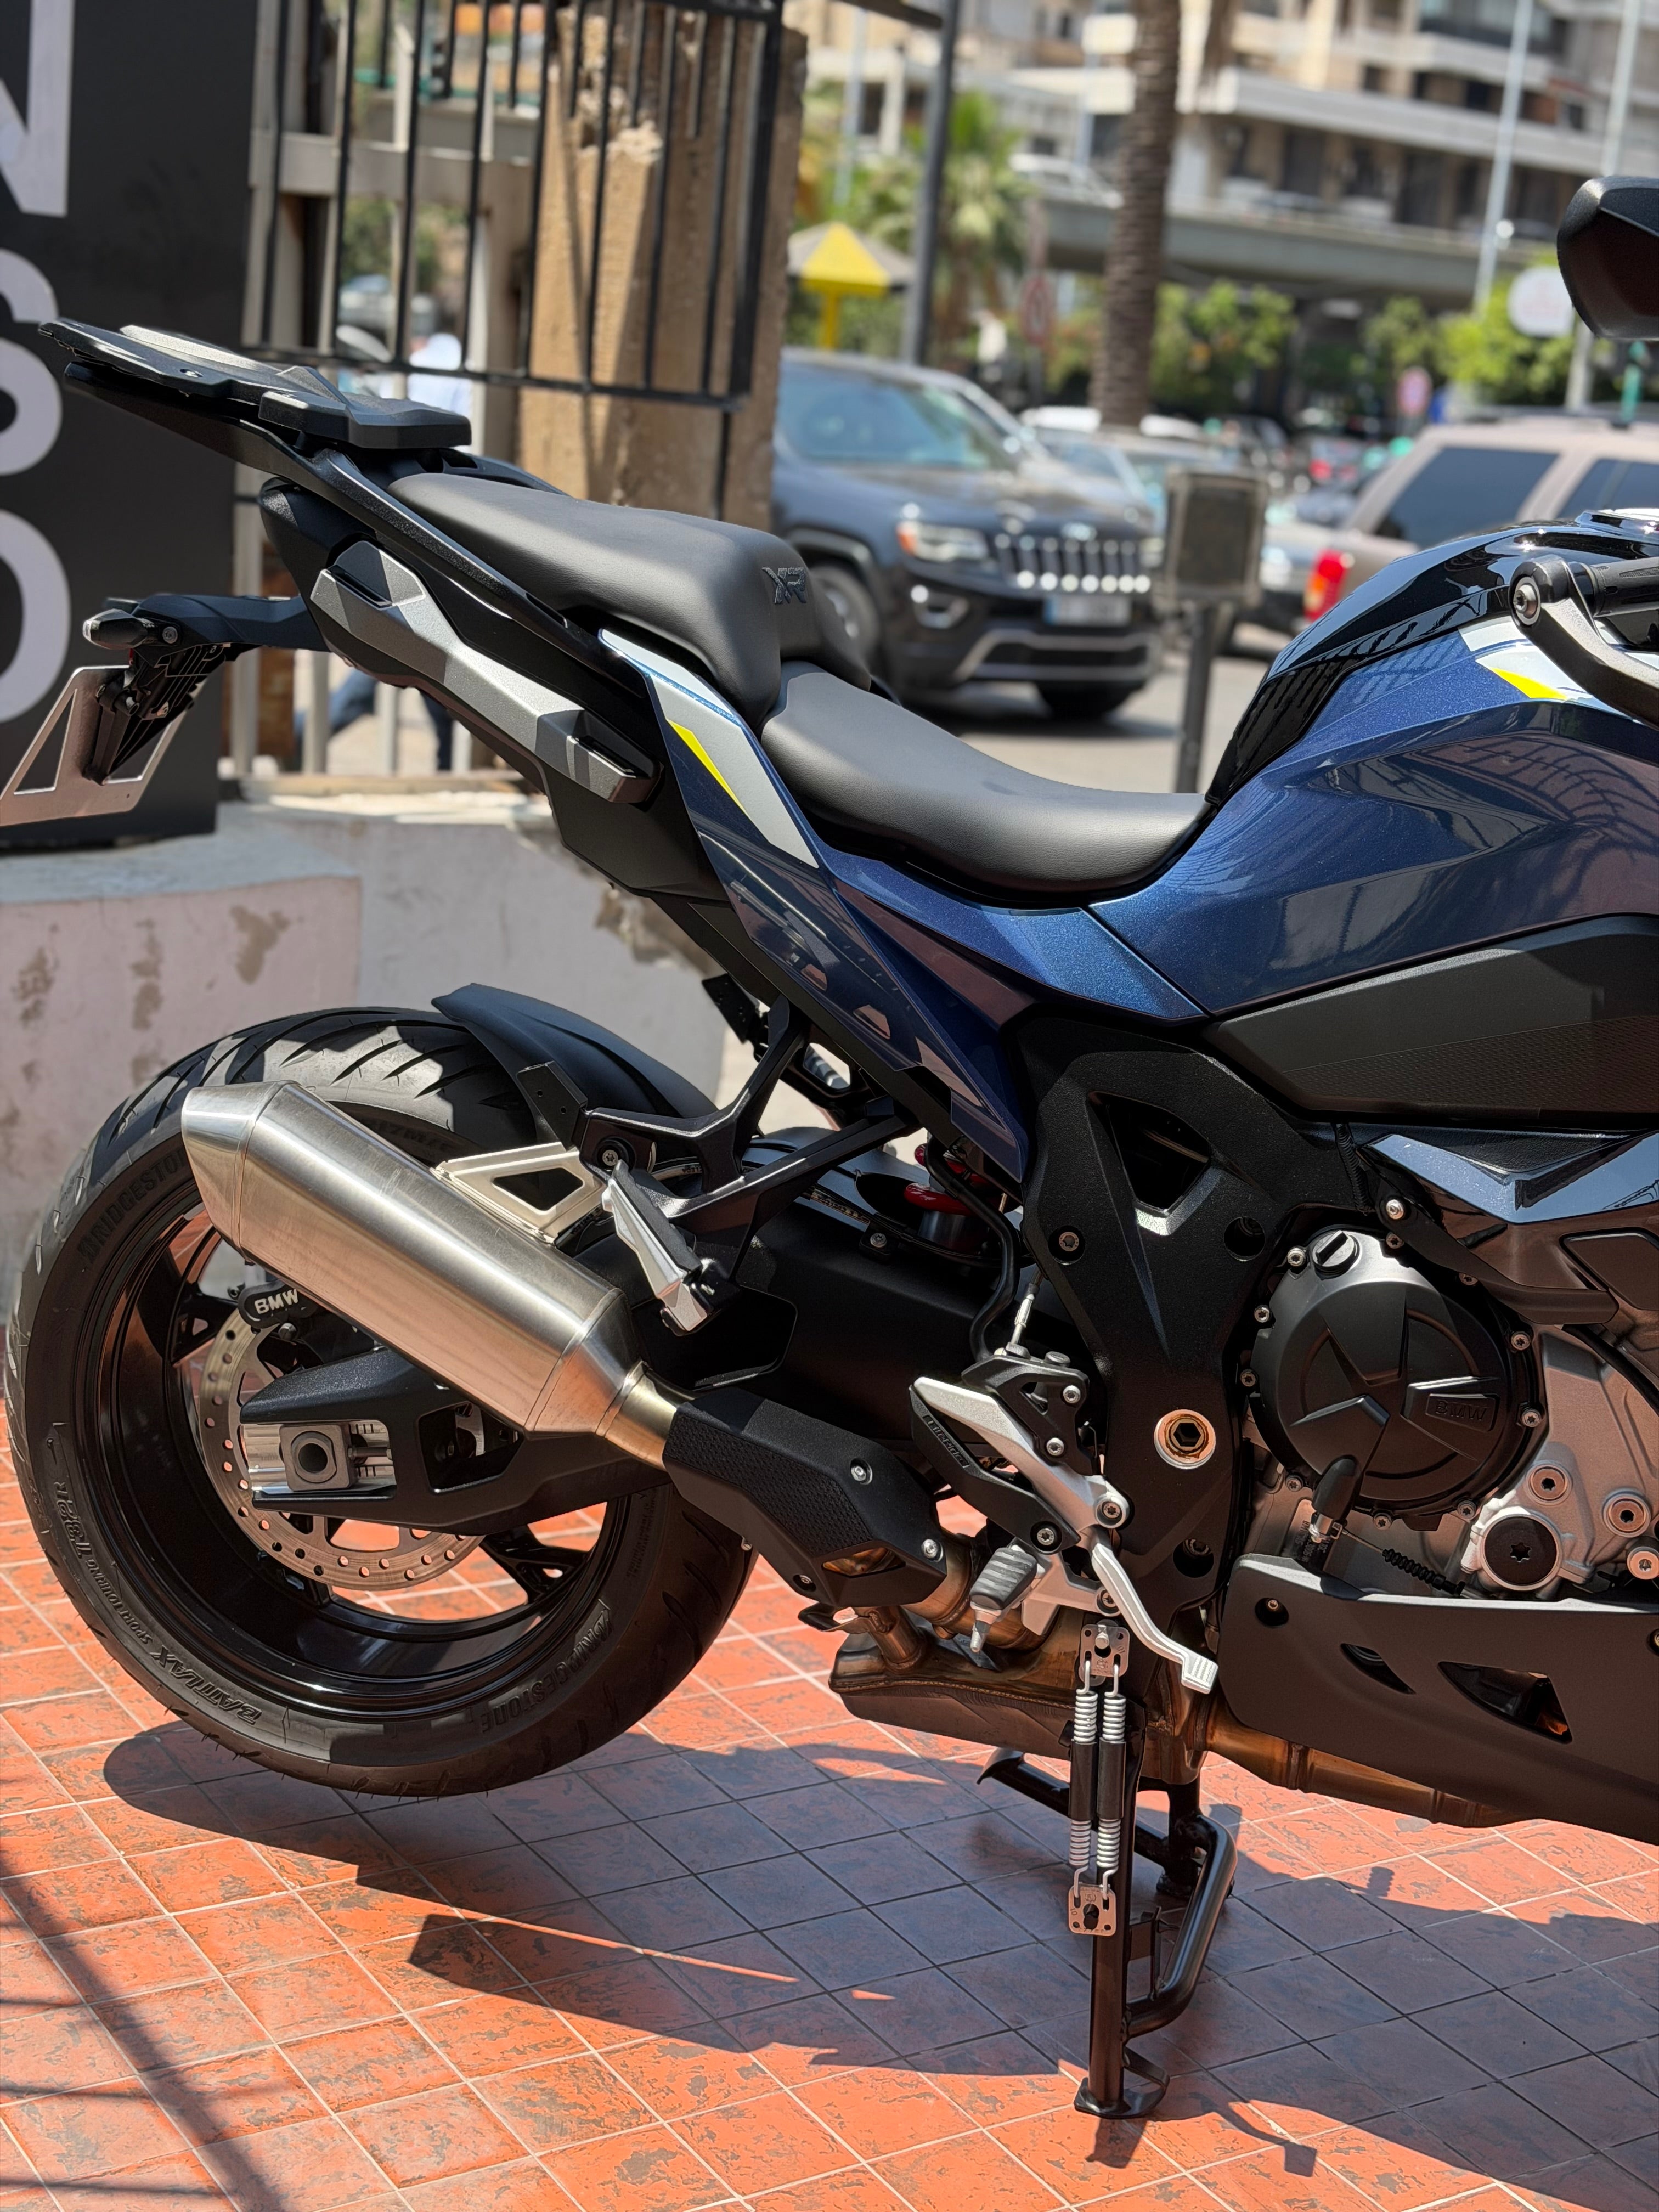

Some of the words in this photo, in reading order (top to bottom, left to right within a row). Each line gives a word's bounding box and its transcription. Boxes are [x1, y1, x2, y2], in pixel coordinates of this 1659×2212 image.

[761, 567, 807, 605] XR
[254, 1289, 299, 1314] BMW
[1434, 1398, 1489, 1421] BMW
[86, 1558, 123, 1610] TOURING
[117, 1610, 153, 1644] SPORT
[149, 1644, 263, 1725] BATTLAX
[480, 1610, 613, 1734] BRIDGESTONE
